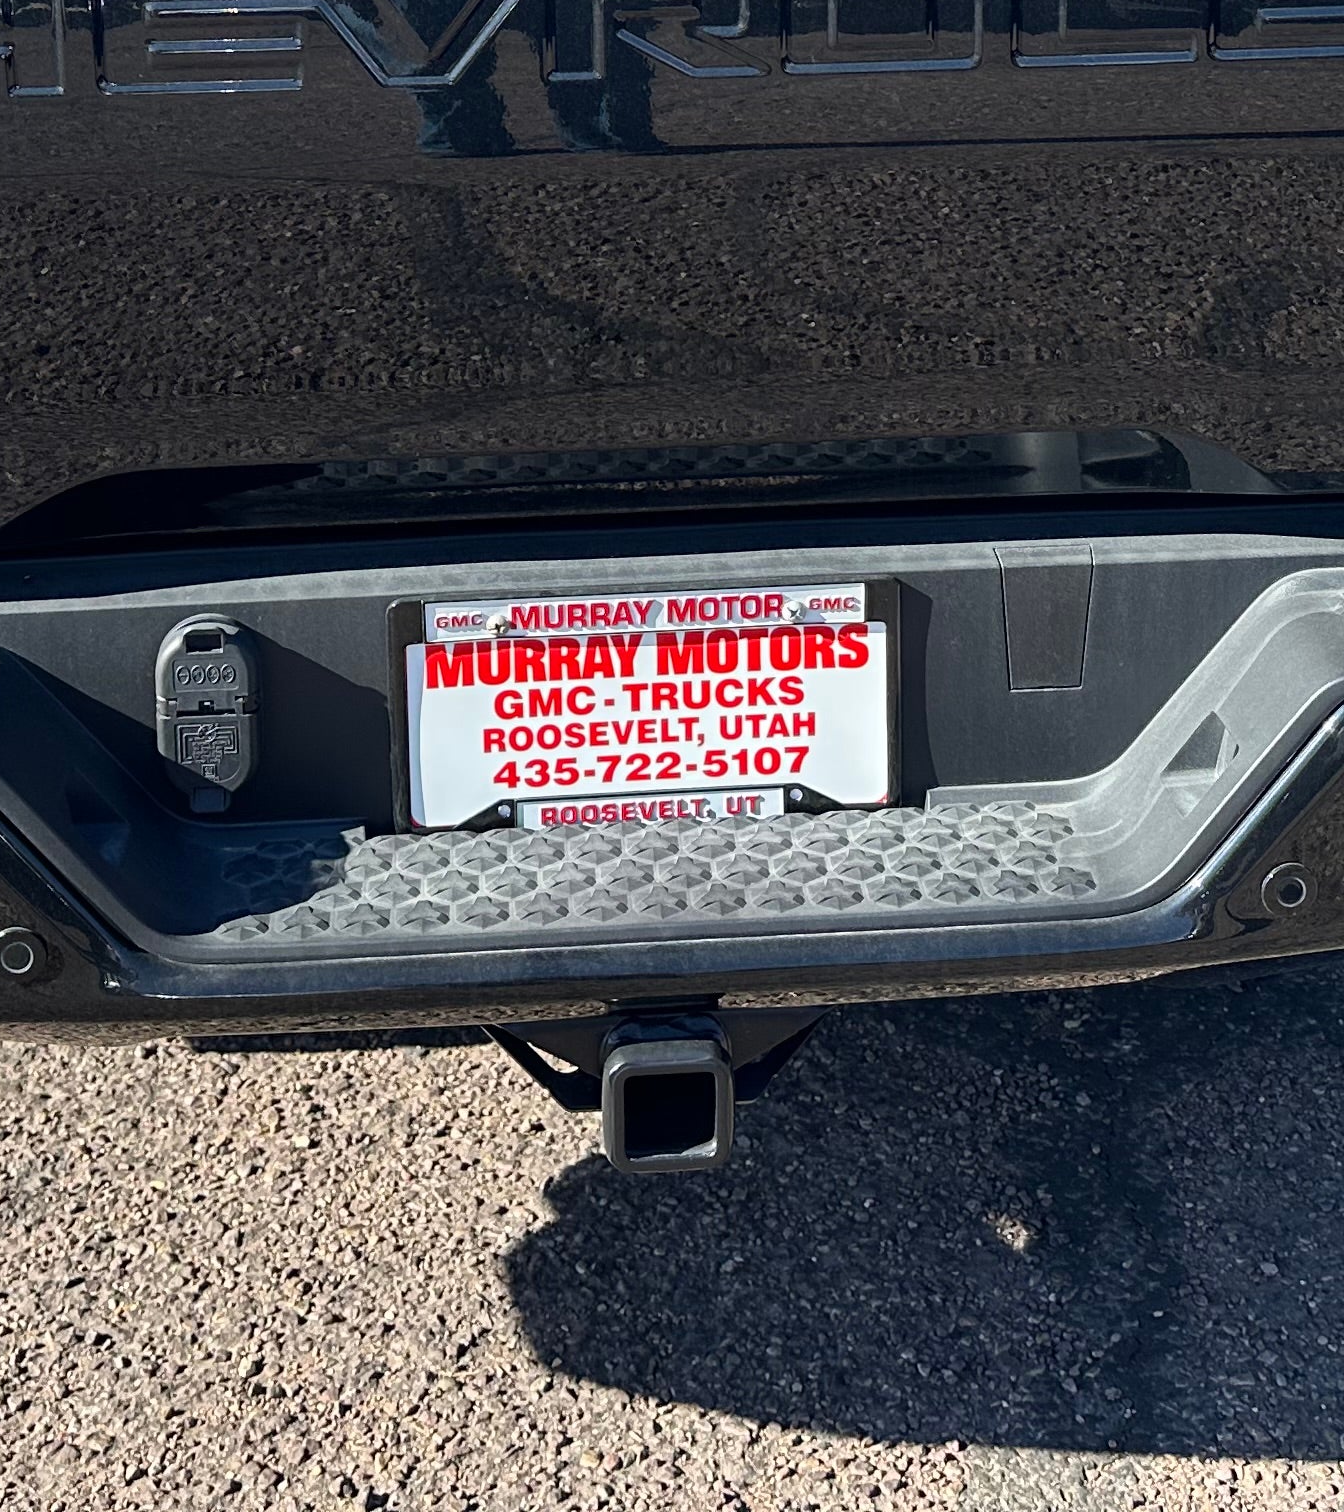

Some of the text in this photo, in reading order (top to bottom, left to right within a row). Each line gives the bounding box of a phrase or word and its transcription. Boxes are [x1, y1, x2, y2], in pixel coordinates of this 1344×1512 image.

[436, 613, 483, 629] GMC
[509, 599, 654, 630] MURRAY
[808, 597, 855, 610] GMC
[424, 623, 870, 689] MURRAY MOTORS
[483, 711, 816, 754] ROOSEVELT, UTAH
[492, 745, 810, 788] 435-722-5107
[725, 795, 761, 816] UT
